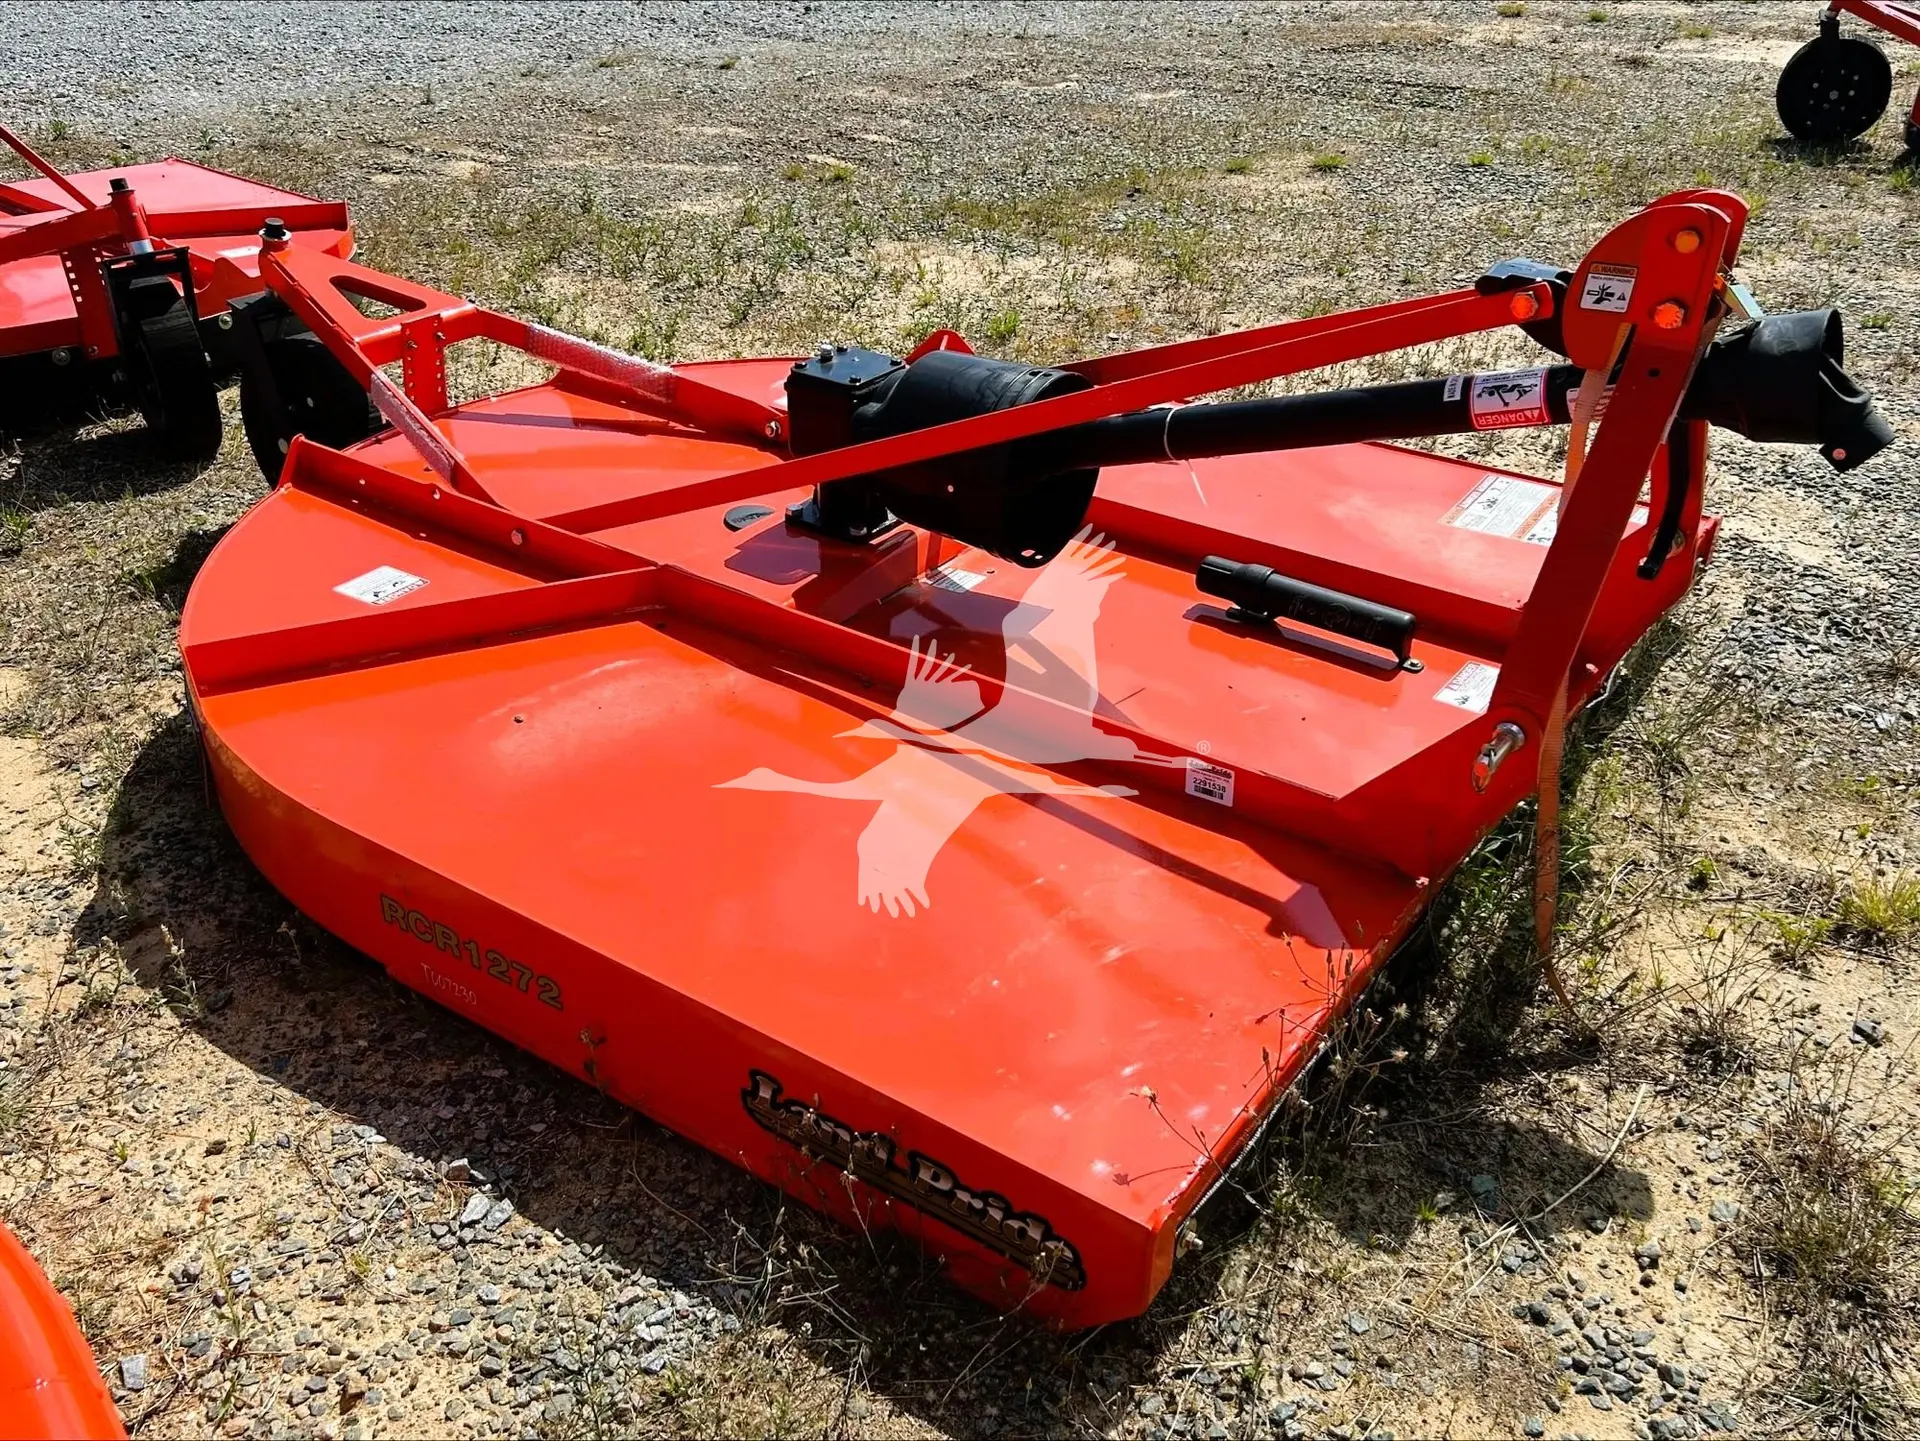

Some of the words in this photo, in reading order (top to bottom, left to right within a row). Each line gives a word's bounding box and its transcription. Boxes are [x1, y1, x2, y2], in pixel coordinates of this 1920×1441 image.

[1601, 265, 1635, 276] WARNING
[1477, 410, 1526, 425] DANGER
[1193, 777, 1226, 792] 2291538
[381, 894, 563, 1010] RCR1272
[744, 1070, 892, 1172] Land
[912, 1156, 1078, 1273] Pride
